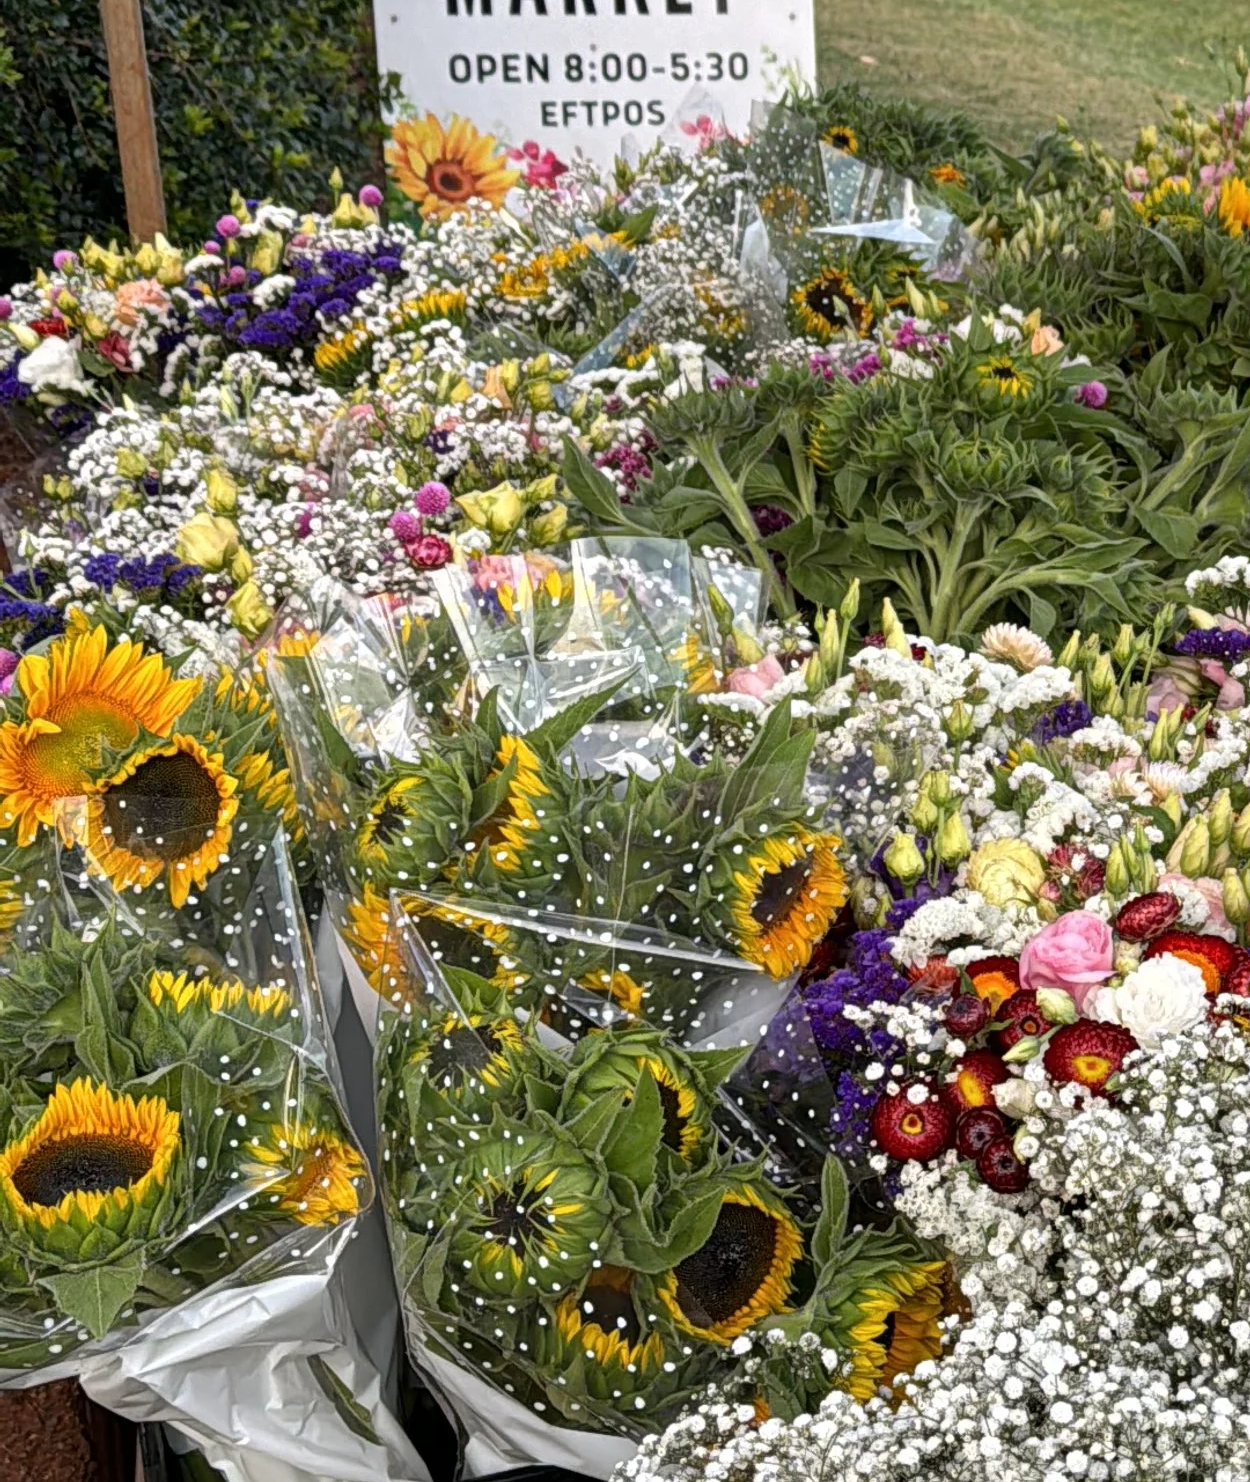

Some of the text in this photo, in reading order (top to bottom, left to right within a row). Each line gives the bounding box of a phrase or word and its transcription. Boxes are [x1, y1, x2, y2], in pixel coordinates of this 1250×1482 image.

[449, 52, 749, 84] OPEN 8:00-5:30
[541, 100, 666, 127] EFTPOS
